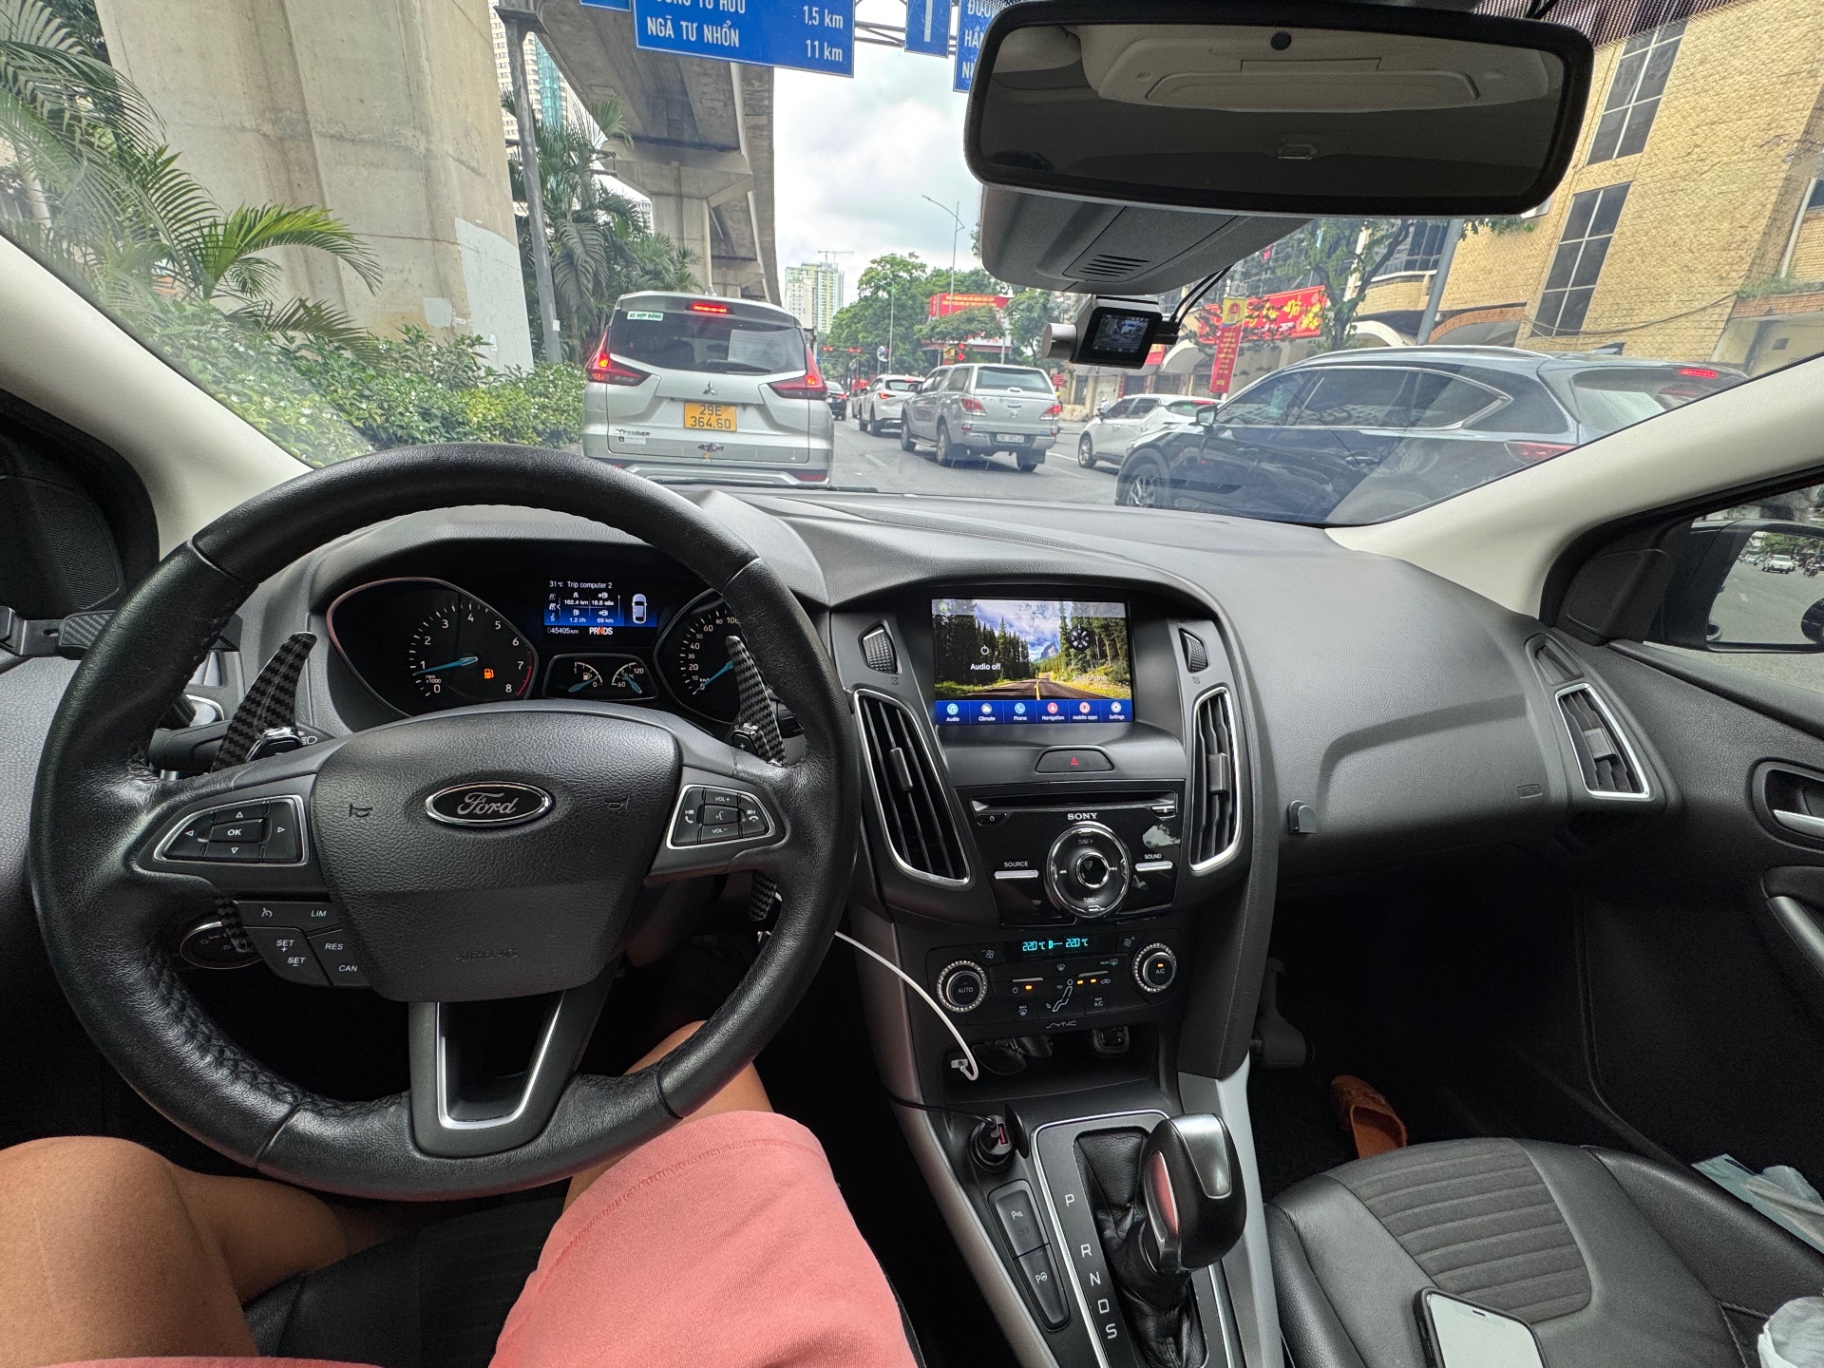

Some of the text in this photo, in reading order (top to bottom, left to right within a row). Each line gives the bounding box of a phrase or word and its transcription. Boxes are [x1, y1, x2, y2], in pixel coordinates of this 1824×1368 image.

[824, 9, 844, 30] km
[646, 15, 739, 48] NGÃ TƯ NHỔN
[805, 39, 843, 62] 11 km
[699, 404, 723, 417] 29E
[690, 416, 731, 430] 364.60
[467, 613, 474, 623] 4
[441, 619, 449, 629] 3
[495, 620, 501, 630] 5
[703, 624, 714, 632] 60
[424, 635, 431, 646] 2
[512, 637, 520, 647] 6
[689, 642, 701, 650] 40
[420, 660, 426, 670] 1
[517, 660, 524, 670] 7
[688, 663, 699, 671] 20
[970, 662, 990, 671] Audio
[433, 684, 441, 694] 0
[505, 684, 513, 693] 8
[456, 791, 520, 815] Ford
[1067, 812, 1098, 821] SONY
[227, 827, 242, 836] OK
[1003, 860, 1029, 868] SOURCE
[310, 909, 328, 918] LIM
[275, 939, 295, 948] SET
[324, 942, 344, 951] RES
[287, 956, 307, 965] SET
[338, 964, 359, 973] CAN
[957, 986, 974, 994] AUTO
[1064, 1193, 1076, 1207] P
[1080, 1243, 1093, 1258] R
[1089, 1272, 1101, 1286] N
[1097, 1298, 1110, 1314] D
[1105, 1323, 1118, 1339] S
